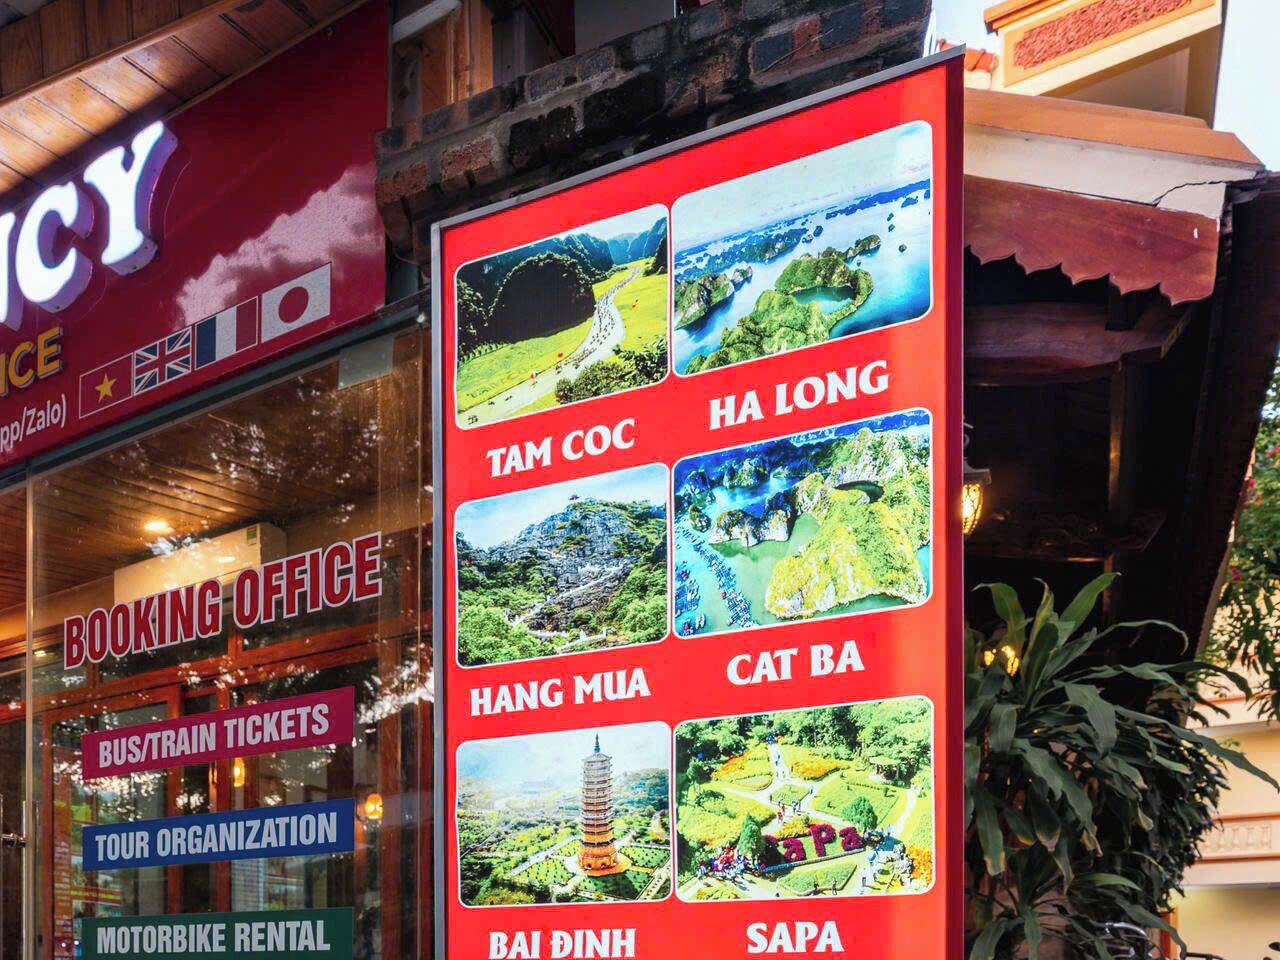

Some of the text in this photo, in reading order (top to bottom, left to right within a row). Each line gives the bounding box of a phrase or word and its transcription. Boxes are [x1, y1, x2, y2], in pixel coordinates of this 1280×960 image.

[708, 359, 890, 431] HA LONG
[486, 418, 636, 478] TAM COC
[63, 531, 382, 670] BOOKING OFFICE
[726, 639, 865, 686] CAT BA
[469, 667, 651, 717] HANG MUA
[98, 703, 330, 769] BUS/TRAIN TICKETS
[95, 812, 337, 862] TOUR ORGANIZATION
[765, 823, 864, 863] aPa
[96, 919, 331, 954] MOTORBIKE RENTAL
[488, 928, 637, 960] BAI ĐINH
[746, 920, 845, 955] SAPA
